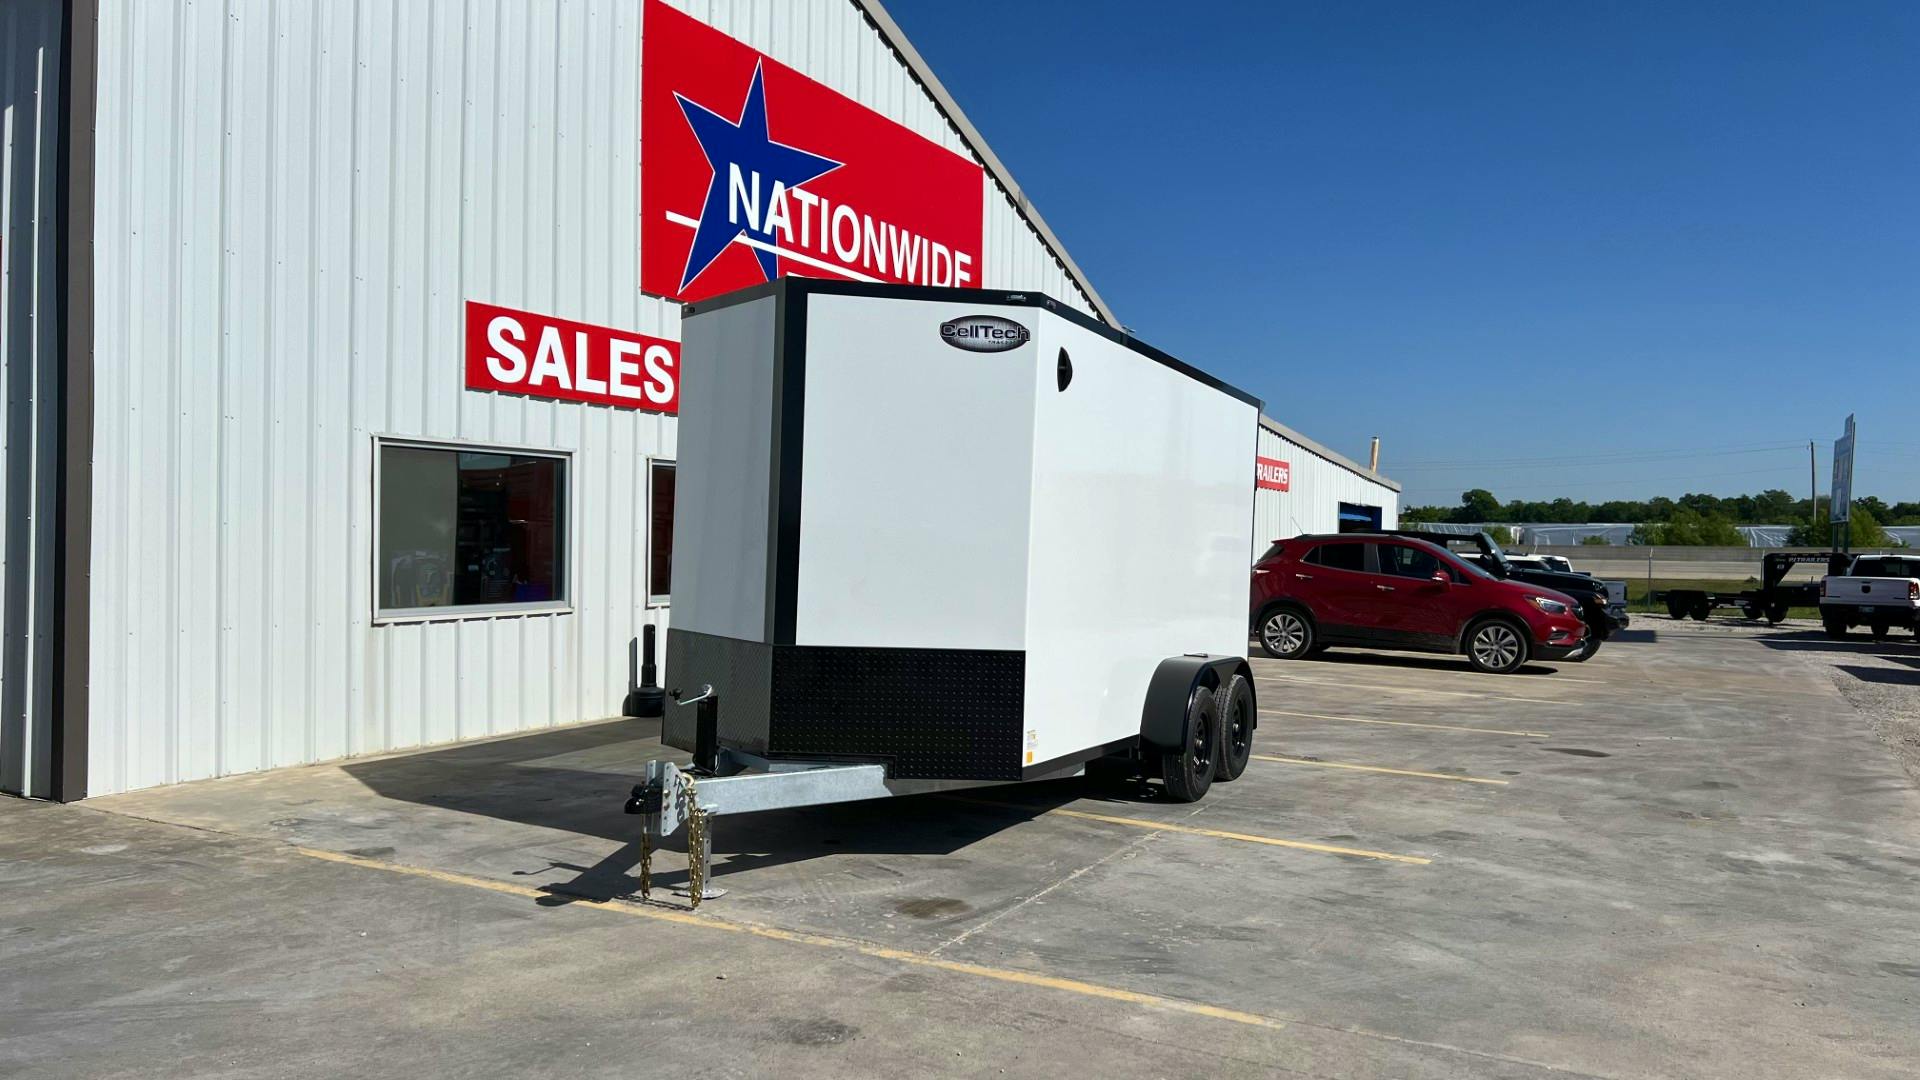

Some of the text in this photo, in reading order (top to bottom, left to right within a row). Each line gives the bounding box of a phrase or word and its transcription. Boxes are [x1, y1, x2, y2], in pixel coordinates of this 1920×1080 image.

[728, 162, 972, 289] NATIONWIDE
[485, 315, 675, 404] SALES
[940, 323, 1030, 341] CellTech
[1256, 463, 1288, 484] RAILERS
